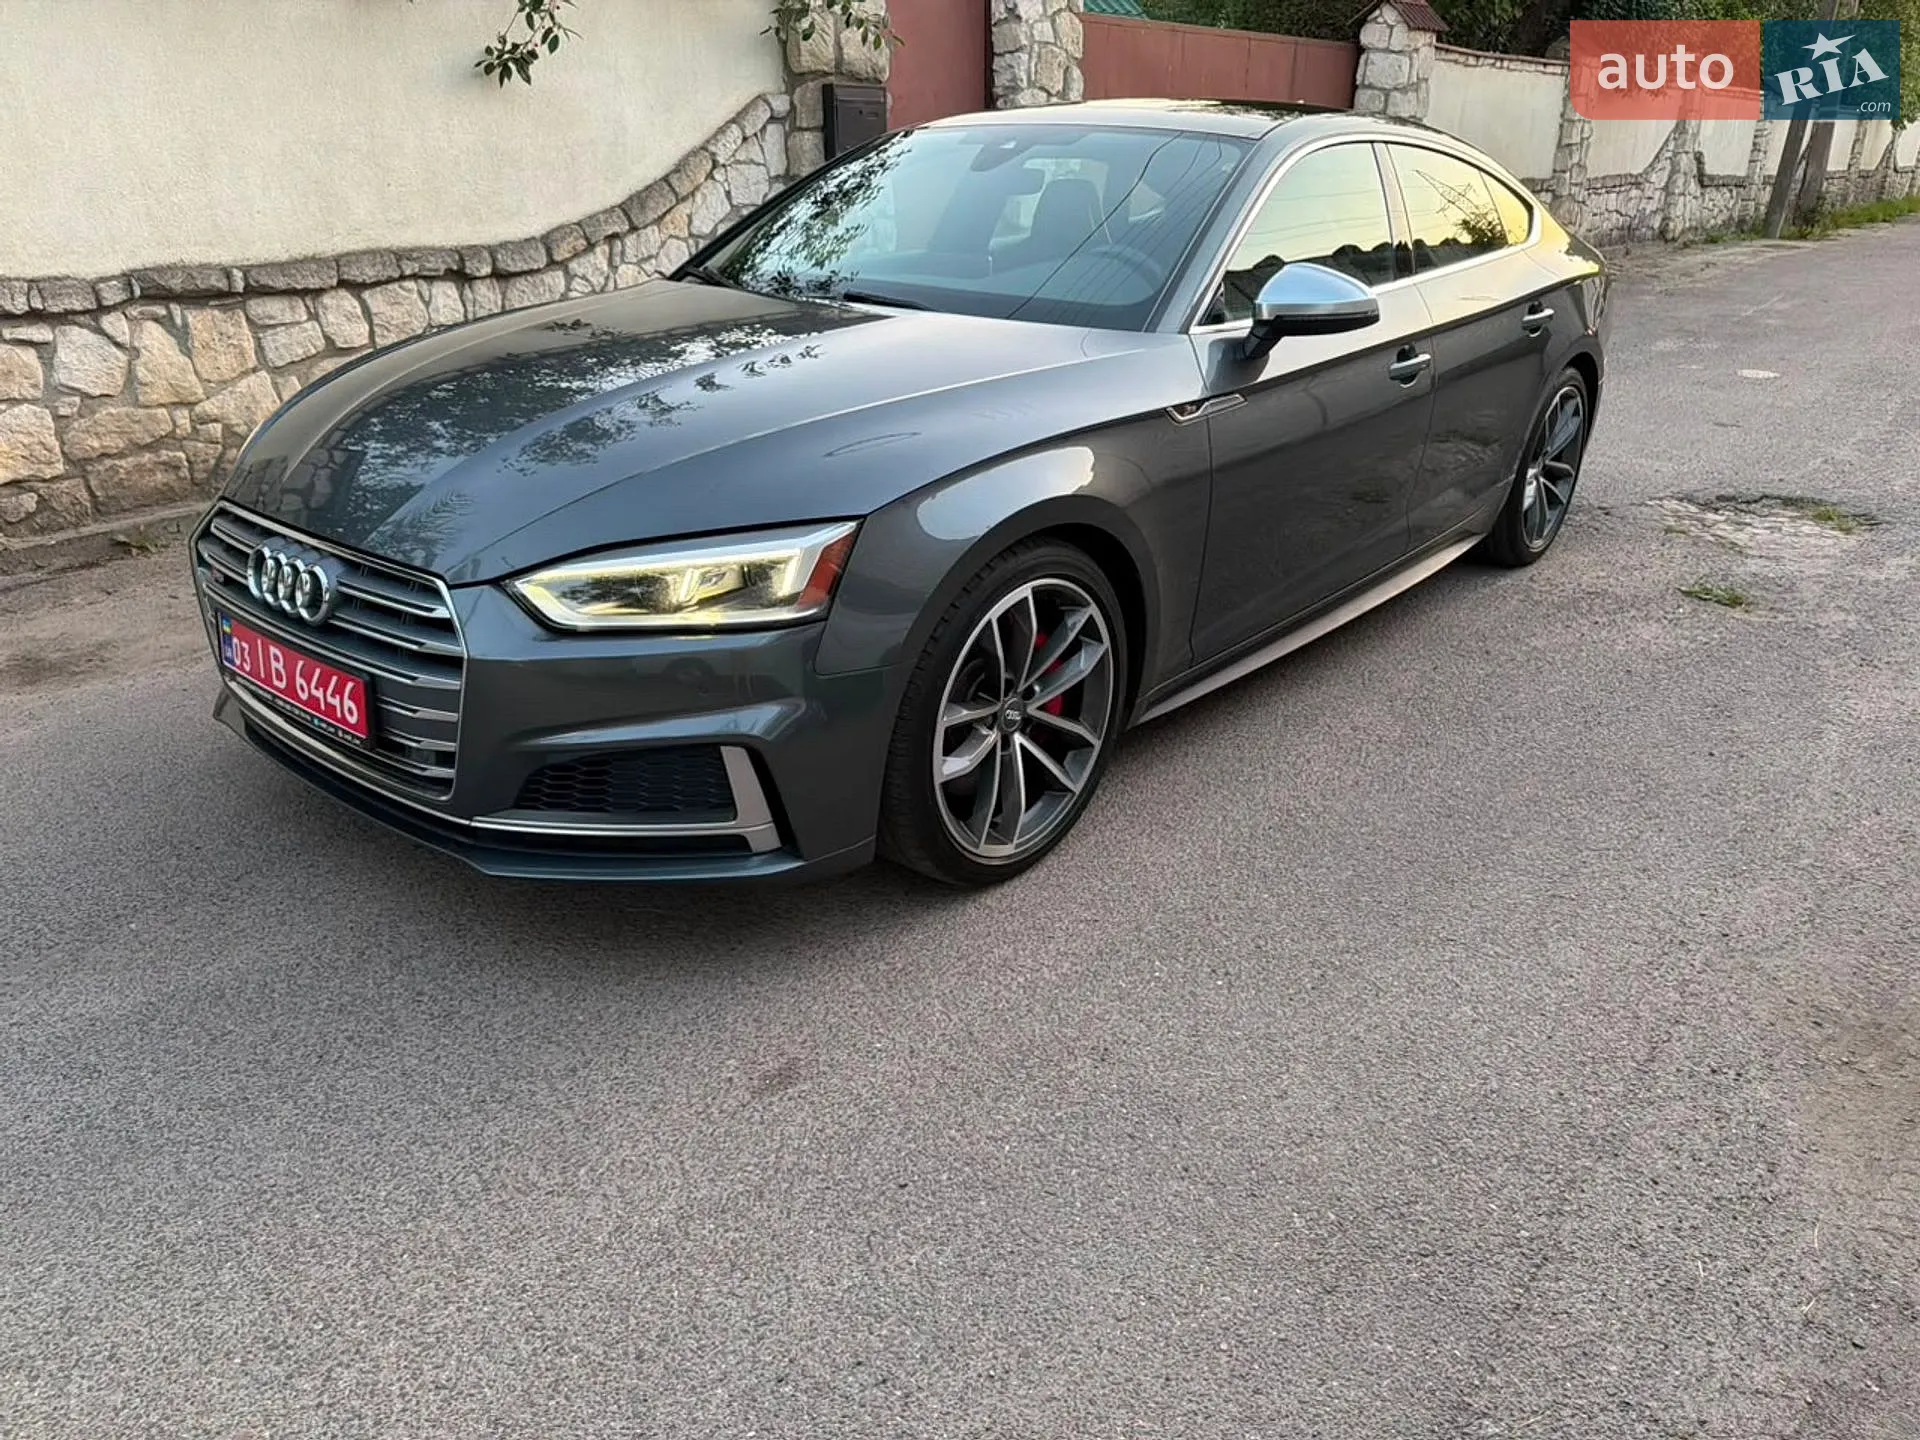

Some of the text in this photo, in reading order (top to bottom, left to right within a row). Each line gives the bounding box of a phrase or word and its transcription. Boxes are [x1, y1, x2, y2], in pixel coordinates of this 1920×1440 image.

[232, 637, 251, 672] 03
[257, 638, 287, 690] IB
[295, 660, 359, 725] 6446
